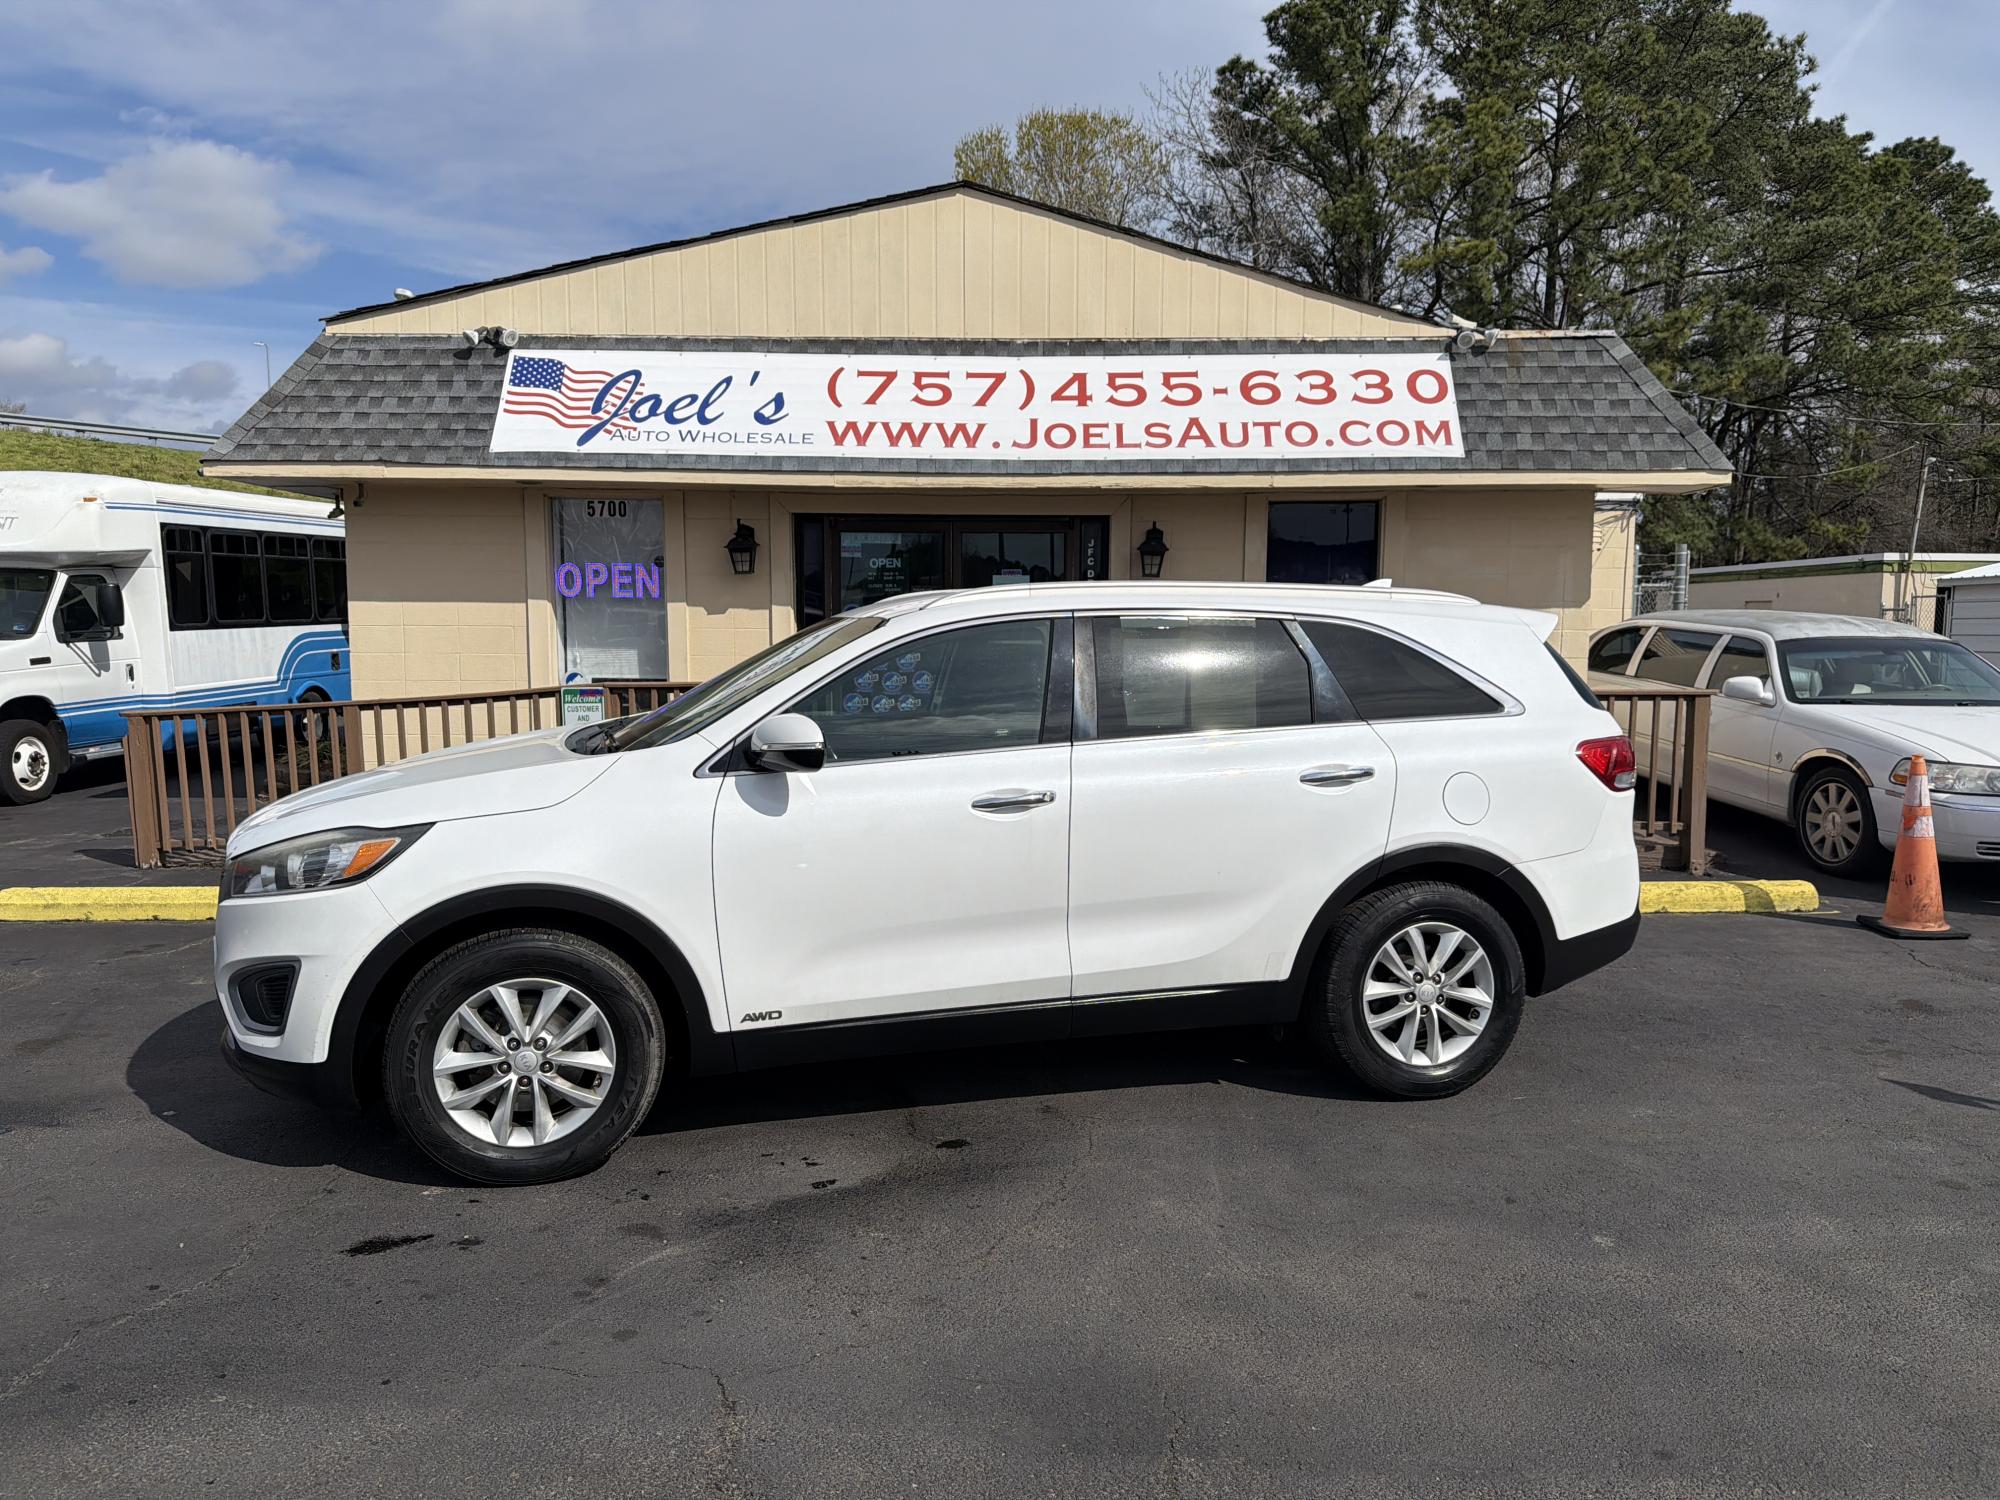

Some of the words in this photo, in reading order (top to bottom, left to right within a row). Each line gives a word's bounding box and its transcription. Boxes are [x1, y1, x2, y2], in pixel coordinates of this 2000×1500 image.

[827, 367, 1448, 410] (757)455-6330
[576, 369, 789, 447] Joel's
[610, 428, 670, 442] AUTO
[678, 429, 814, 445] WHOLESALE
[587, 500, 627, 518] 5700
[869, 557, 902, 569] OPEN
[556, 561, 662, 599] OPEN
[565, 695, 602, 703] Welcome
[567, 705, 600, 713] CUSTOMER
[577, 714, 591, 722] AND
[740, 1010, 783, 1023] AWD
